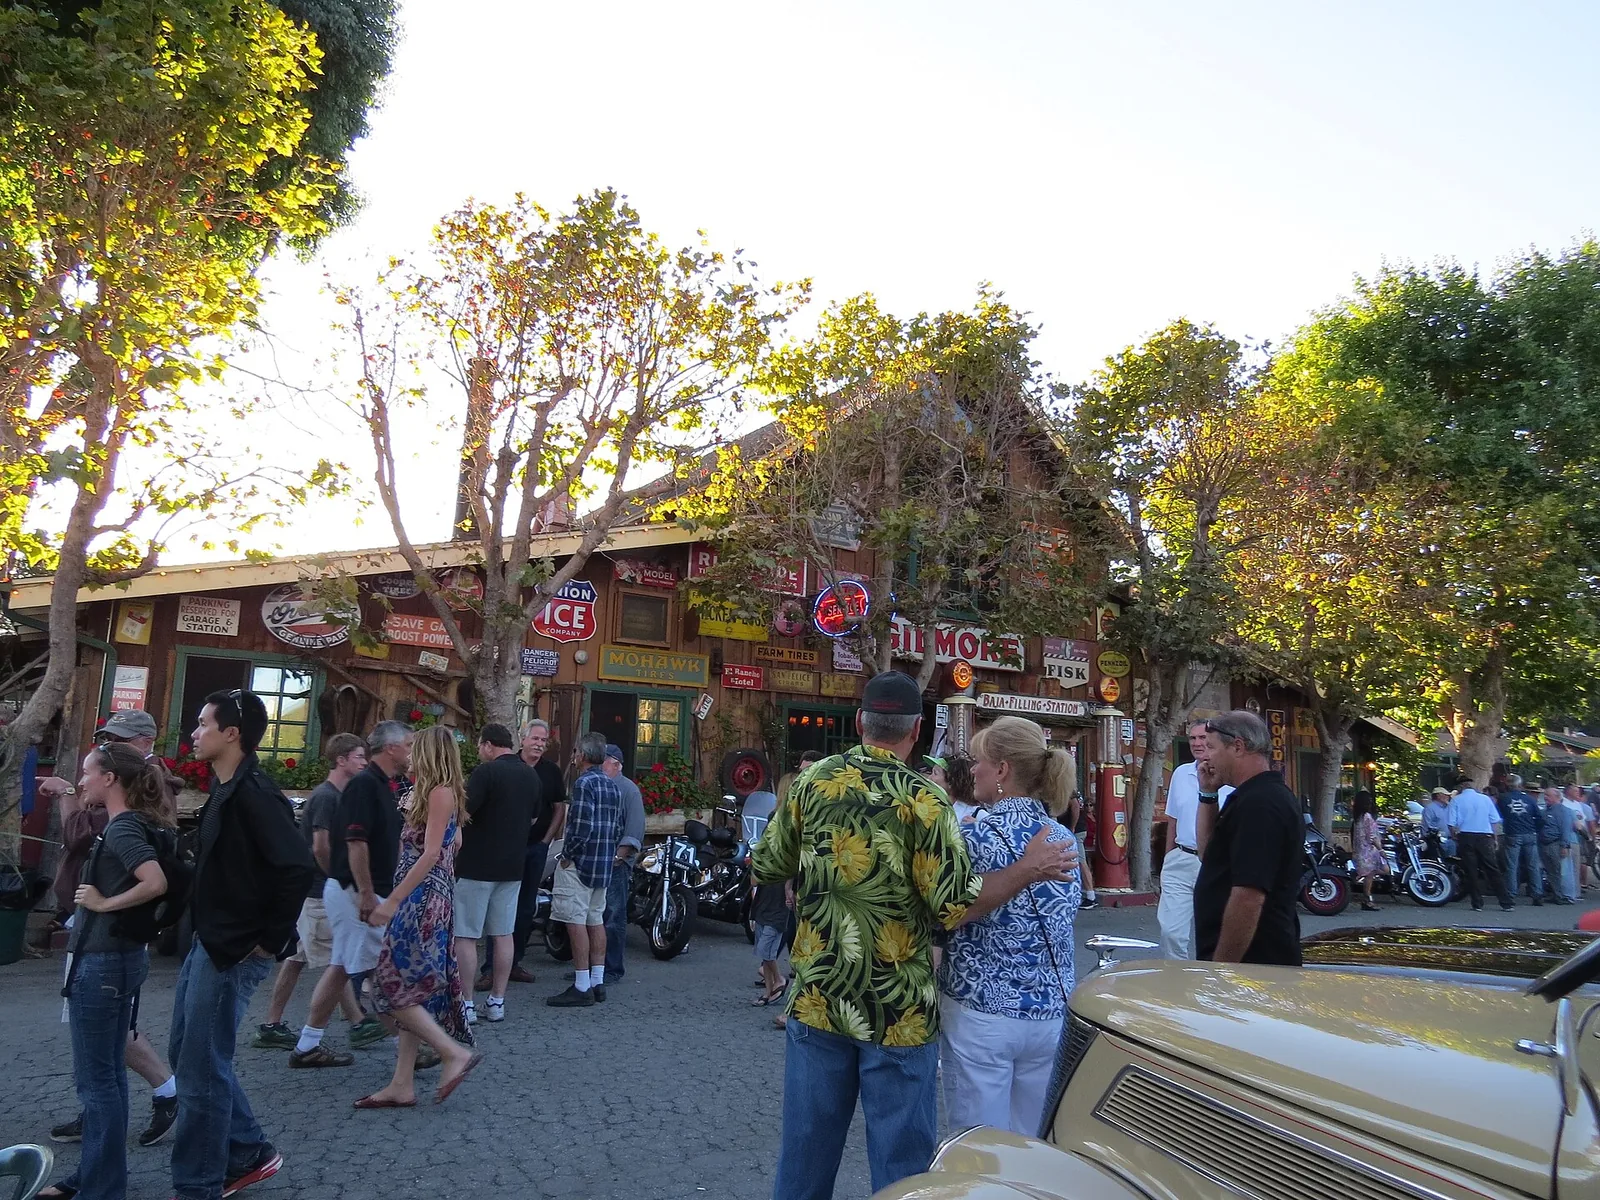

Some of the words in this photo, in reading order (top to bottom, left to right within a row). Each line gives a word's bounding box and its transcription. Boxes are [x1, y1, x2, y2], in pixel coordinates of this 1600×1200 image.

[379, 574, 418, 587] Coope
[643, 569, 675, 581] MODEL
[557, 586, 591, 600] NION
[188, 597, 231, 609] PARKING
[181, 605, 217, 616] RESERVED
[220, 609, 237, 617] FOR
[544, 602, 586, 629] ICE
[182, 614, 221, 625] GARAGE
[225, 618, 233, 626] &
[392, 615, 424, 630] SAVE
[185, 622, 229, 634] STATION
[545, 627, 581, 637] COMPANY
[325, 627, 351, 643] PART
[387, 628, 420, 642] BOOST
[422, 633, 455, 646] POWE
[890, 621, 1020, 663] GILMORE
[757, 646, 784, 658] FARM
[787, 650, 815, 661] TIRES
[609, 651, 701, 673] MOHAWK
[636, 668, 675, 680] TIRES
[734, 668, 760, 678] Rancho
[1046, 663, 1087, 680] FISK
[113, 690, 142, 700] PARKING
[117, 701, 135, 710] ONLY
[983, 694, 1005, 708] BAJA
[1009, 696, 1041, 712] FILLING
[1046, 700, 1078, 714] STATION
[675, 841, 695, 865] 71
